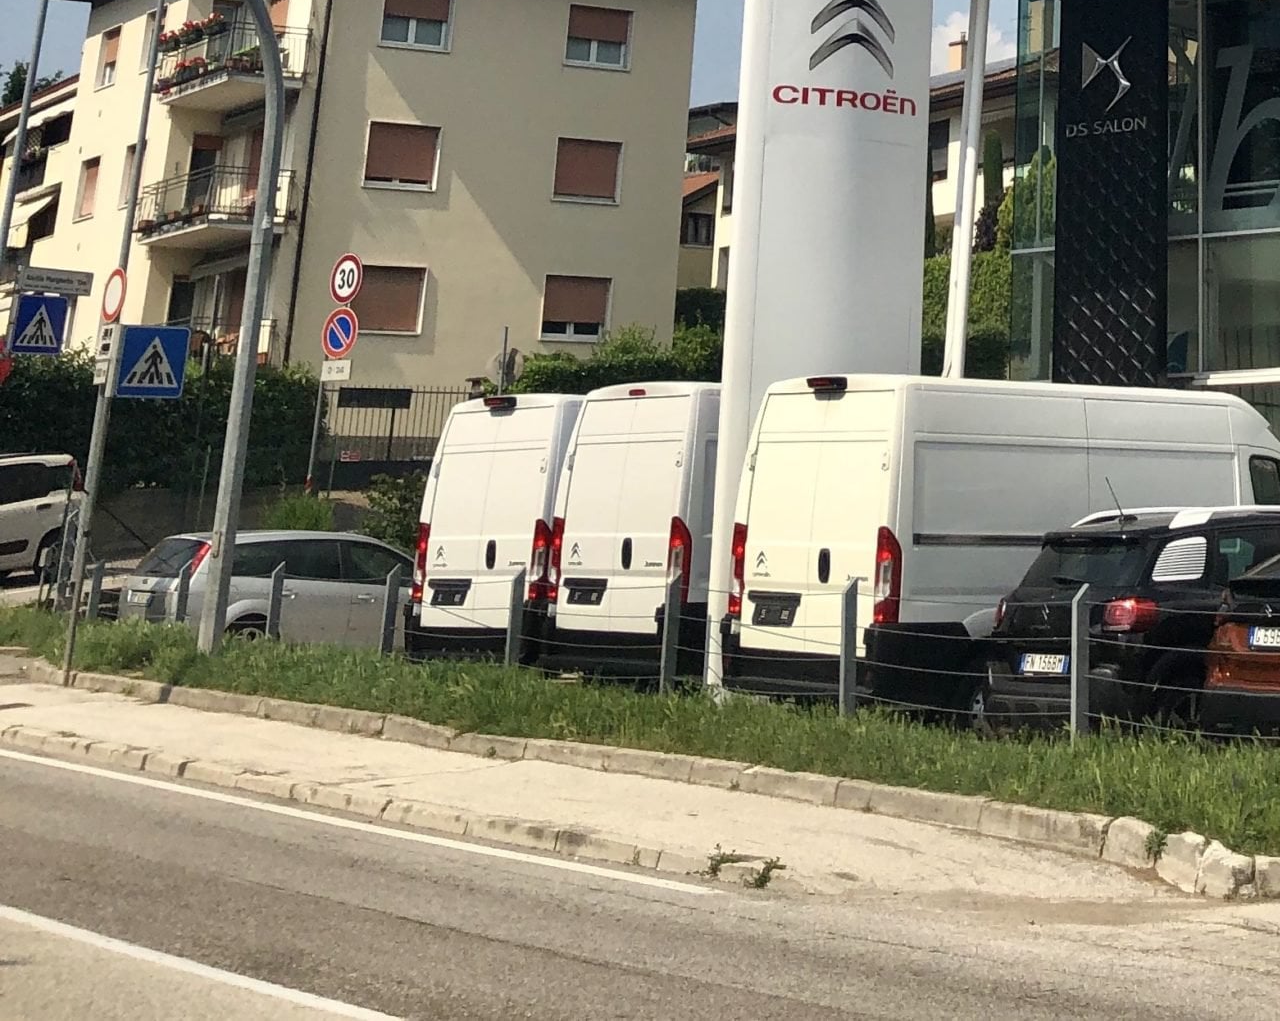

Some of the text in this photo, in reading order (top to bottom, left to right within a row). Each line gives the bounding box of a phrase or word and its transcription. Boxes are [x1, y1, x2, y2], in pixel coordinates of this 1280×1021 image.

[772, 85, 916, 116] CITROËN
[1066, 116, 1146, 138] DS SALON
[338, 267, 355, 290] 30
